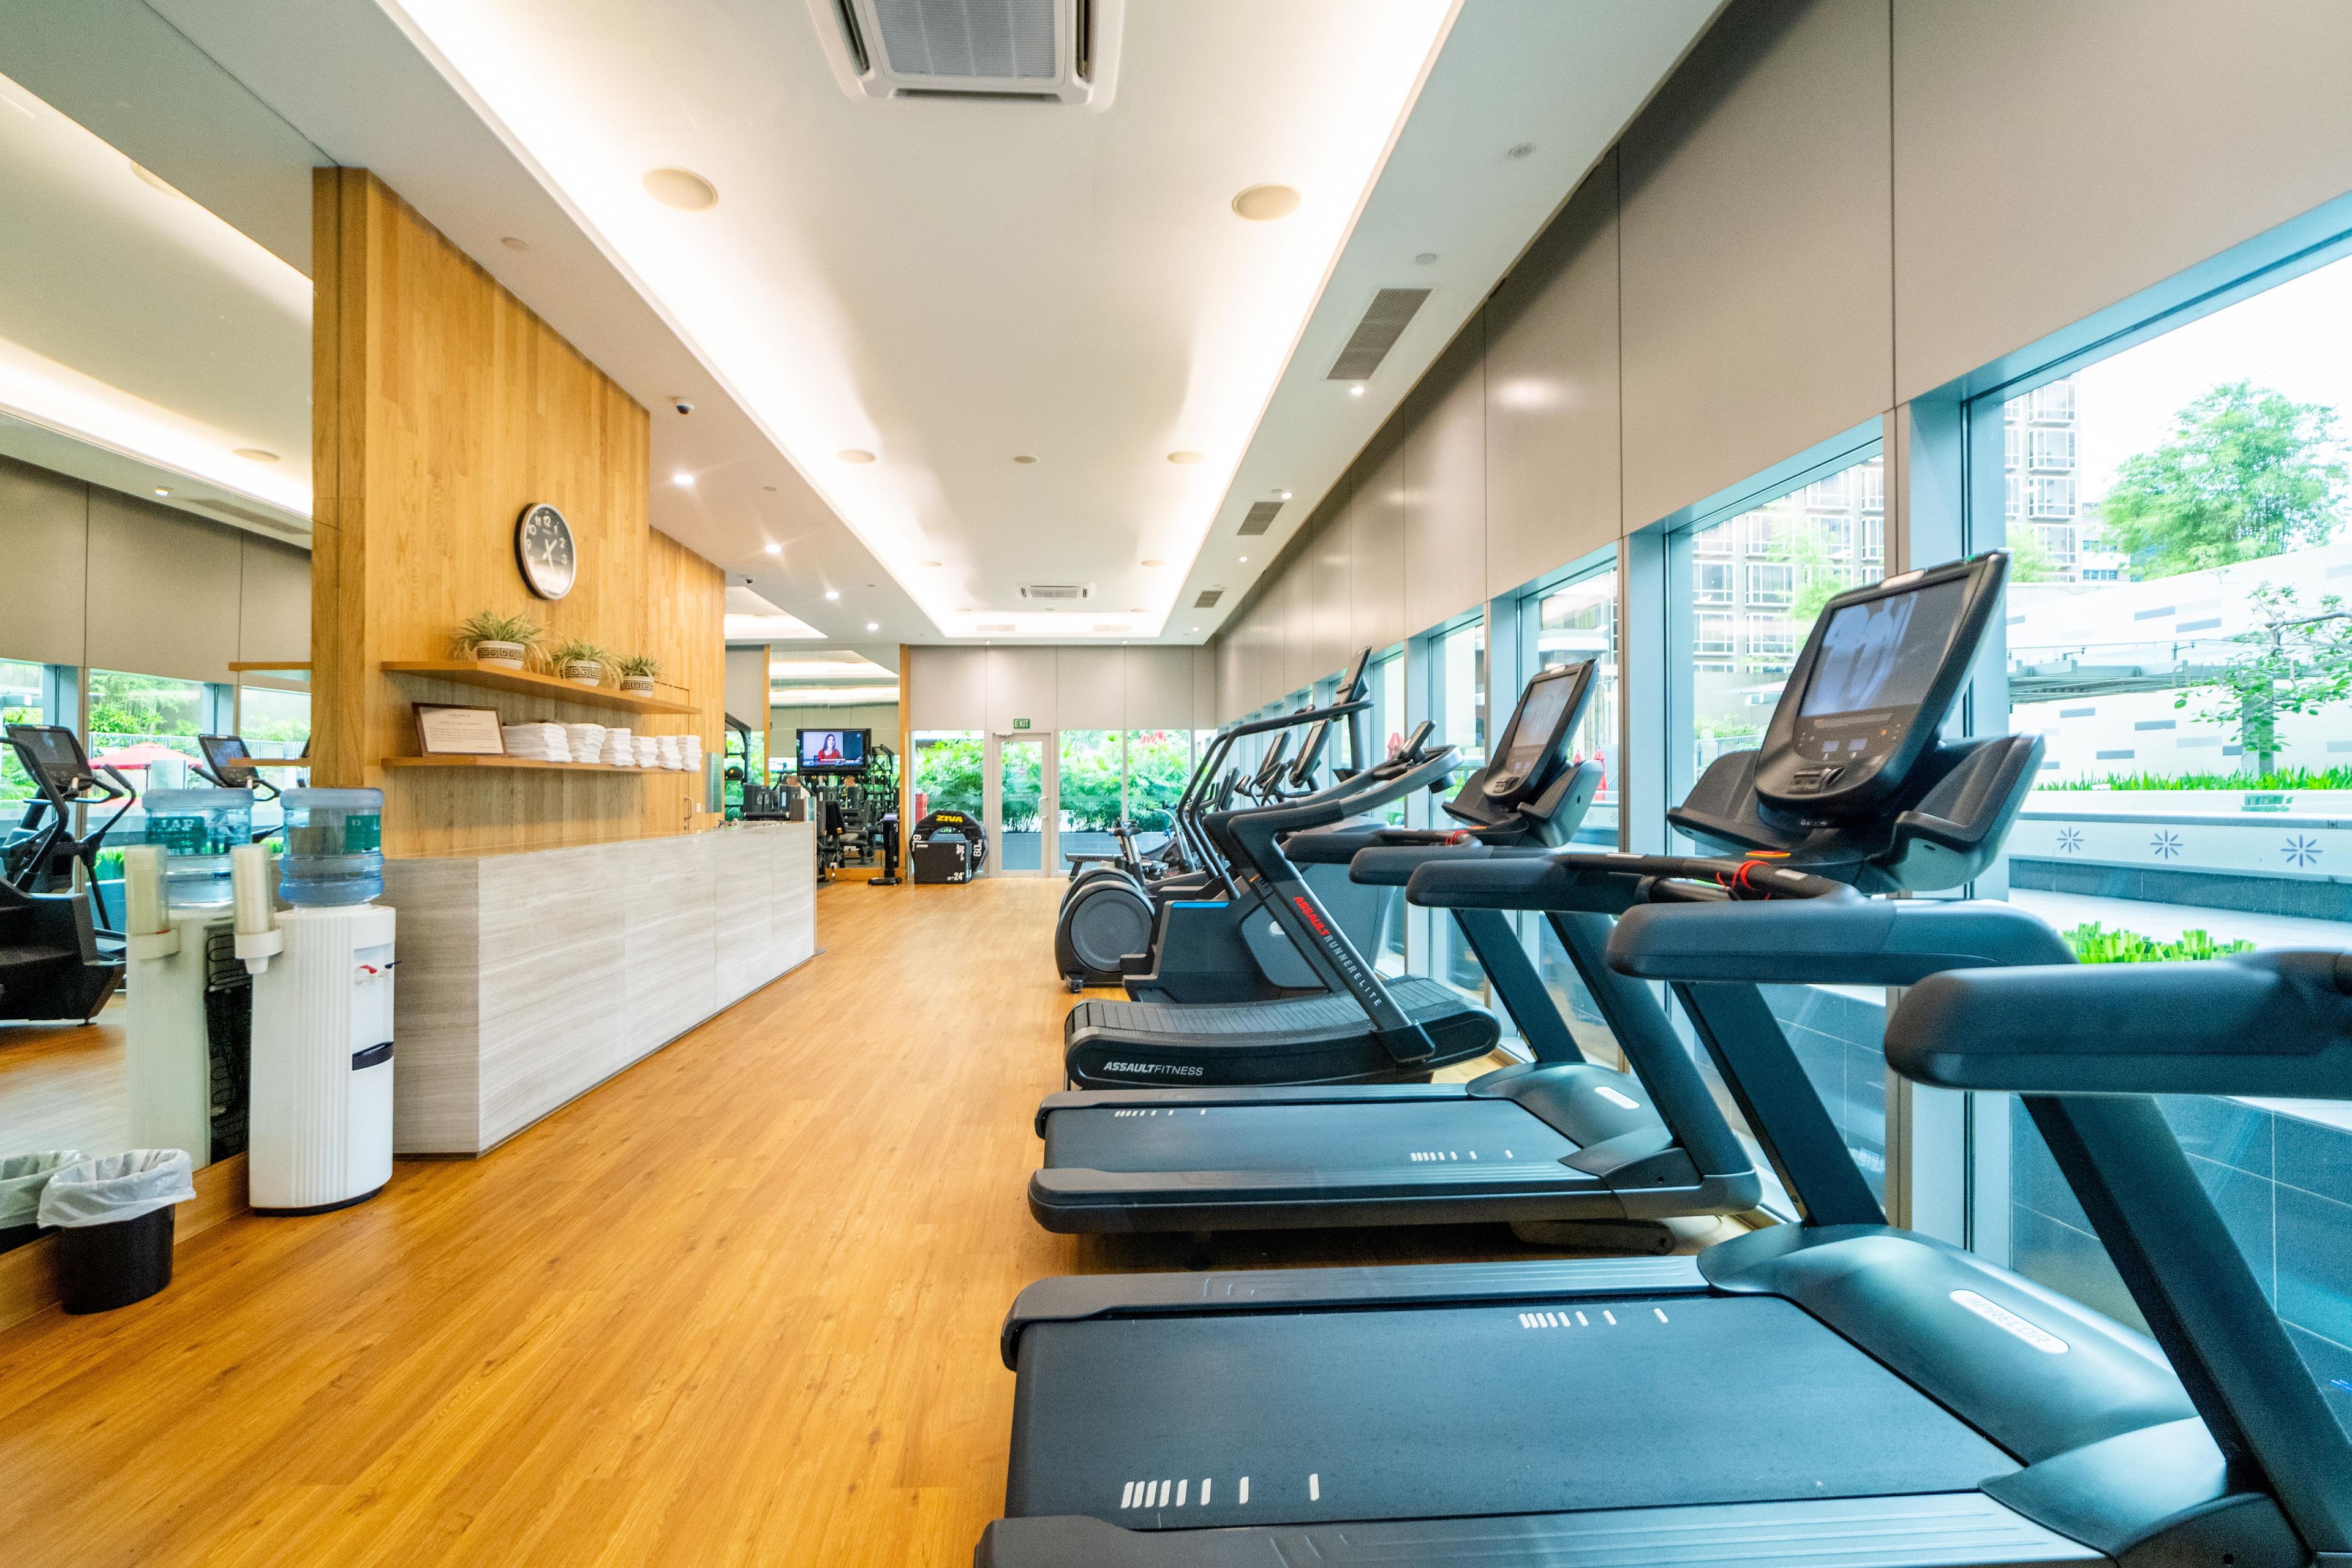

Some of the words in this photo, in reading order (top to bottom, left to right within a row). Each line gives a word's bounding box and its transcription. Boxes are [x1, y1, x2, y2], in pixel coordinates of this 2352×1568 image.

[543, 516, 551, 527] 12
[528, 524, 537, 535] 10
[526, 539, 532, 549] 9
[560, 538, 565, 548] 2
[562, 554, 567, 564] 3
[1354, 972, 1382, 1007] ELITE
[1973, 1303, 2051, 1343] PRECOR
